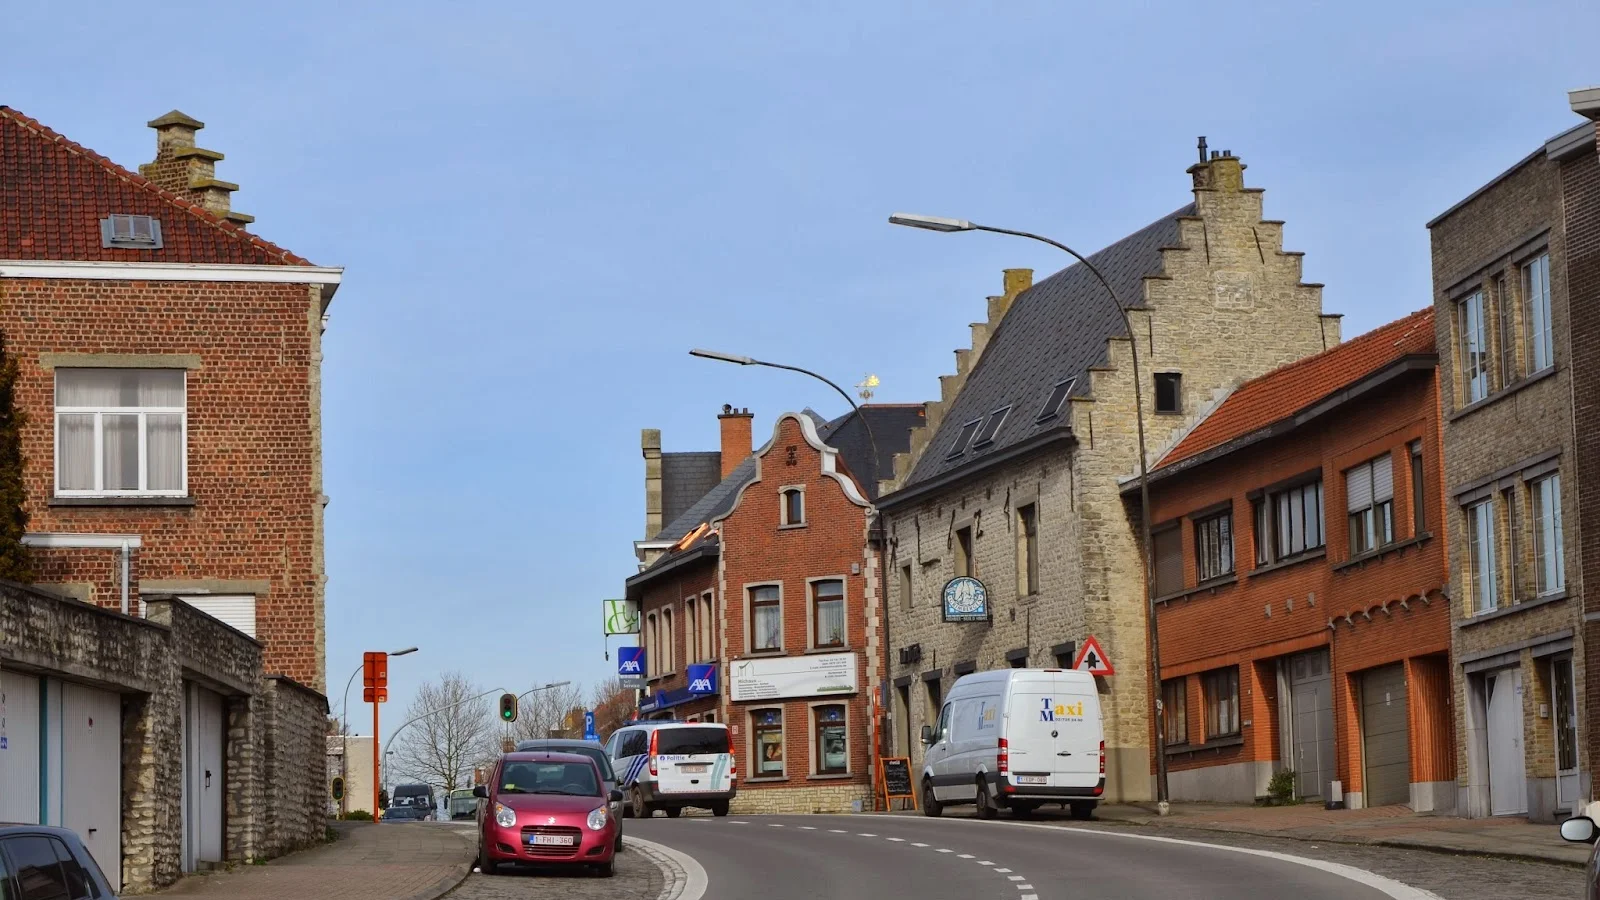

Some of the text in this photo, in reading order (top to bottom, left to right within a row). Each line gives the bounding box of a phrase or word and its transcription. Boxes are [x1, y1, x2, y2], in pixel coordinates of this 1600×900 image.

[619, 660, 640, 672] AXA
[688, 678, 712, 691] AXA
[586, 715, 593, 731] P
[535, 836, 573, 844] 1-FHI-360
